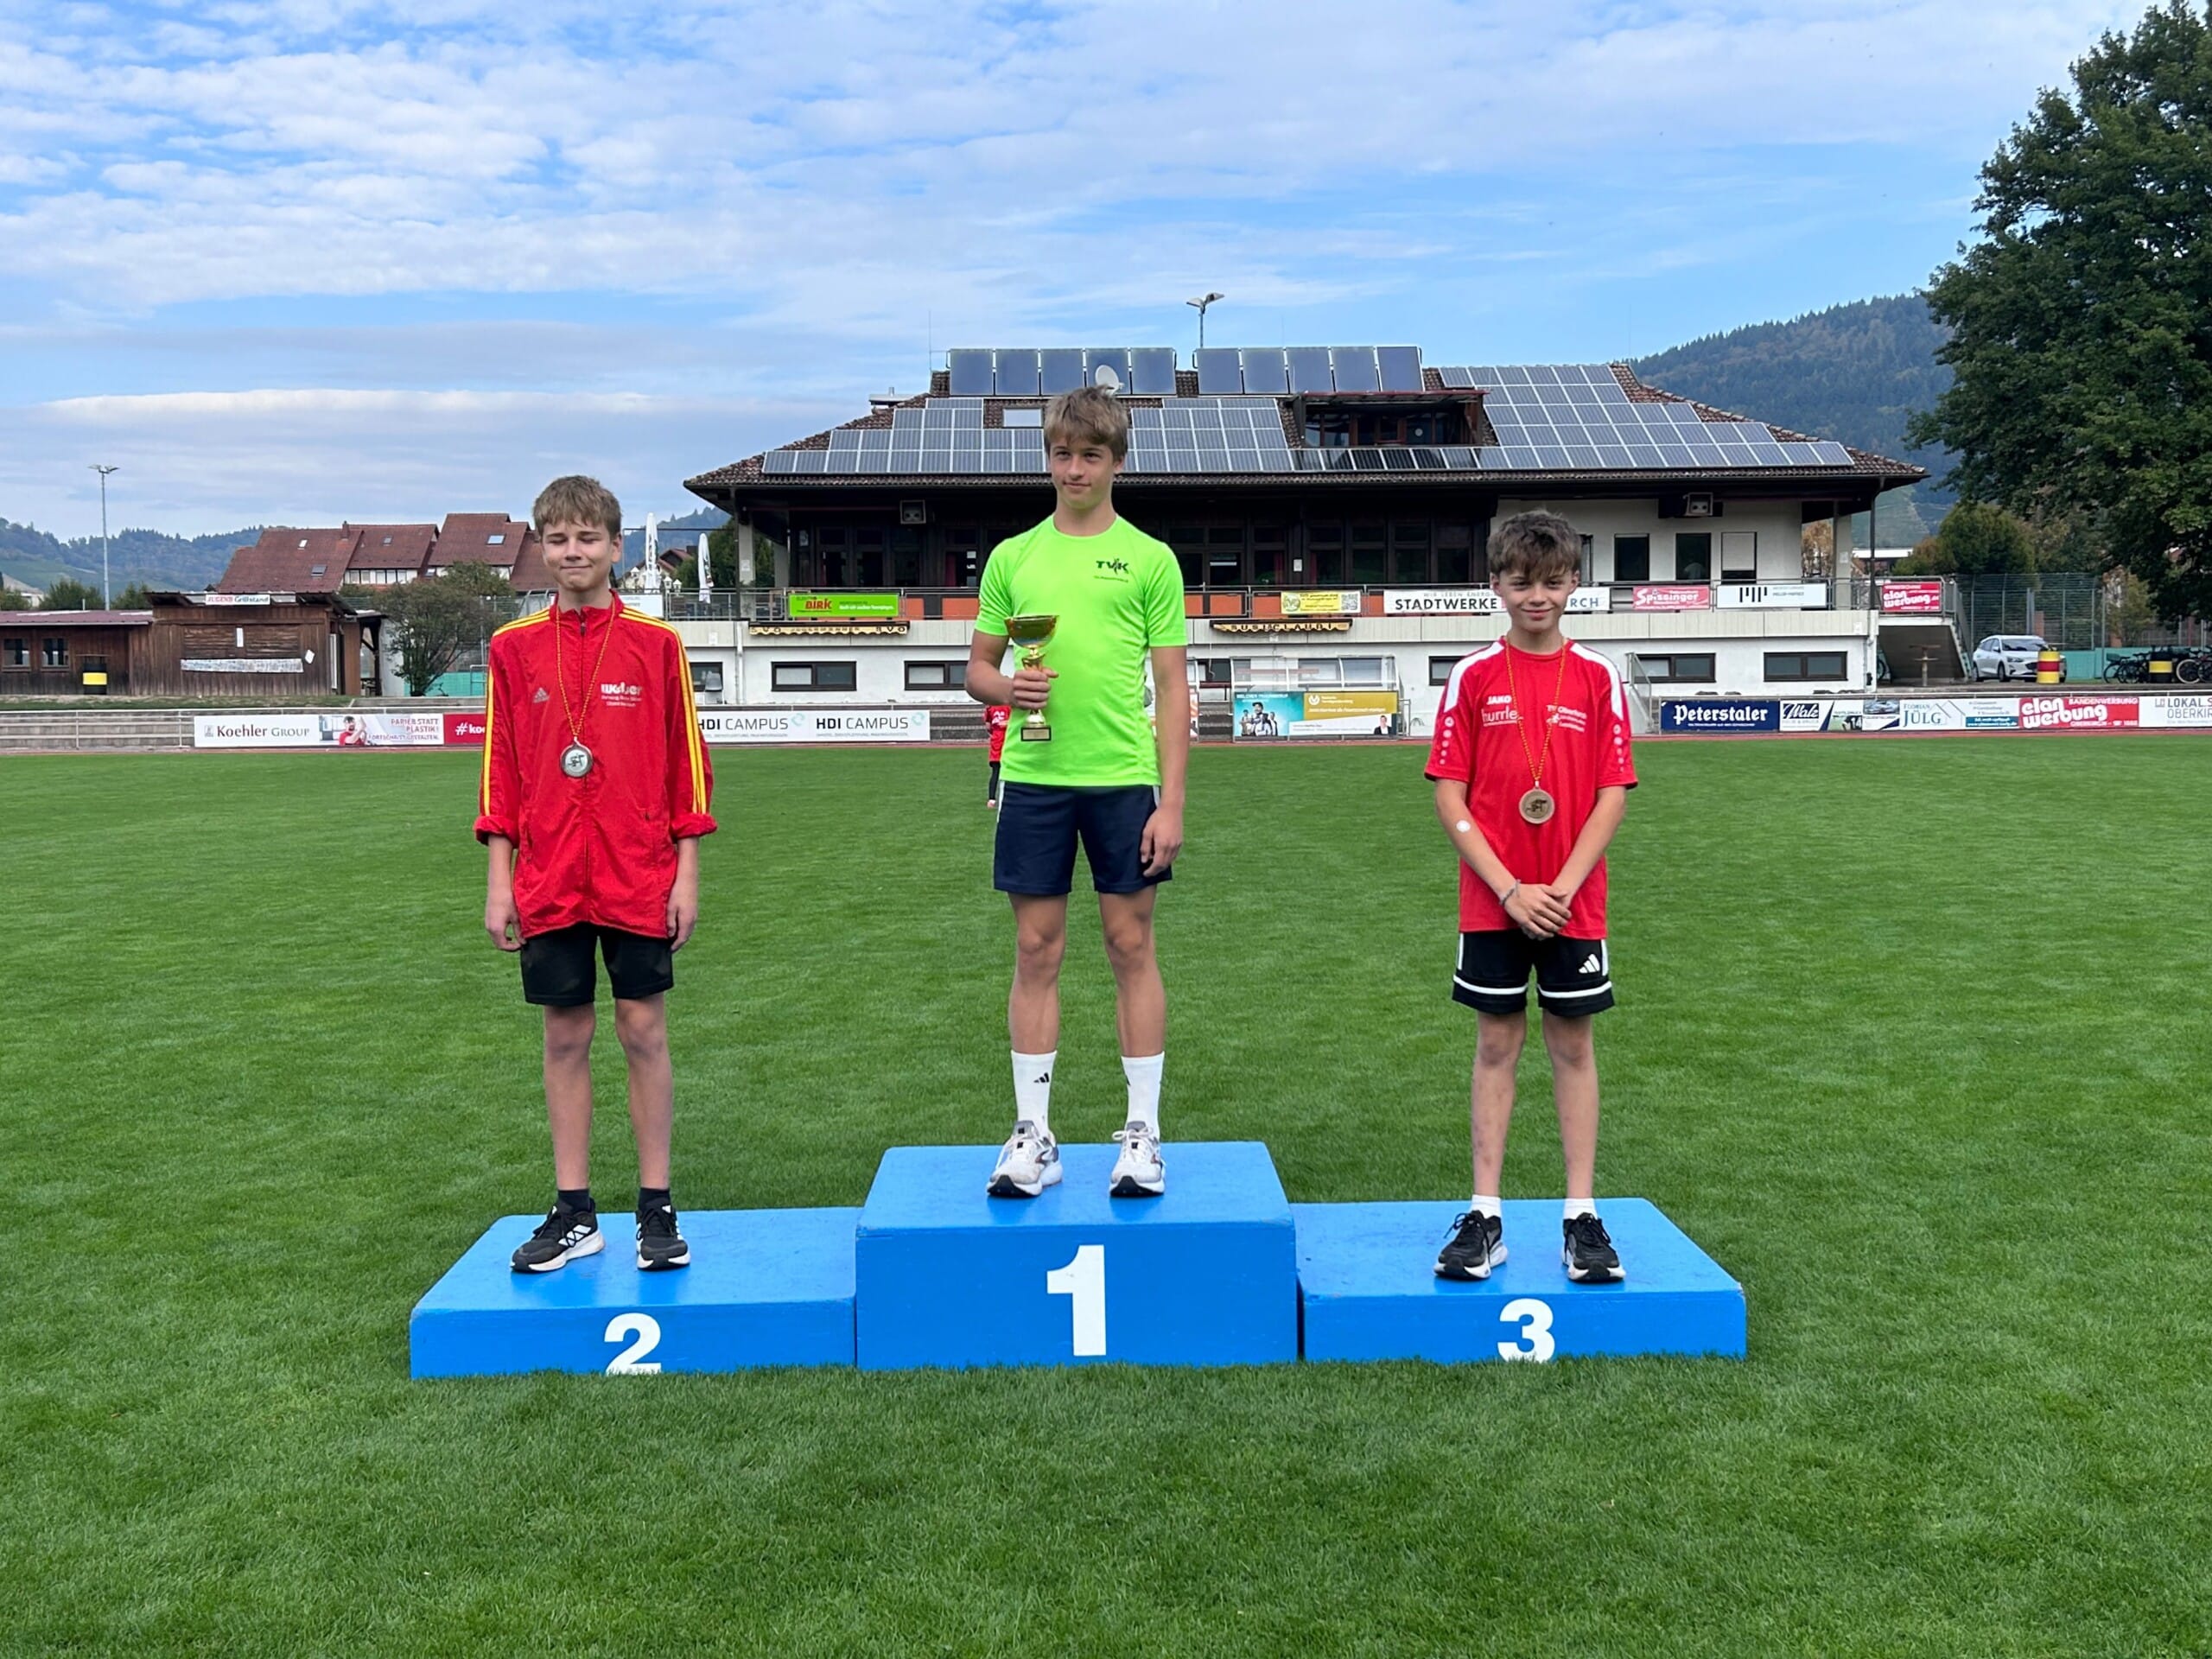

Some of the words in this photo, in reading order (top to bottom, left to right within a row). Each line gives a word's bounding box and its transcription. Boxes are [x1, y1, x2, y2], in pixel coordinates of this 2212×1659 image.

[1395, 598, 1497, 610] STADTWERKE
[1673, 704, 1768, 725] Peterstaler
[1783, 703, 1820, 719] Walz
[2021, 697, 2064, 715] elan
[726, 718, 788, 730] CAMPUS
[817, 718, 841, 729] HDI
[846, 717, 909, 729] CAMPUS
[1851, 717, 1862, 729] 14
[1903, 709, 1942, 728] JÜLG
[2023, 704, 2107, 728] werbung
[217, 724, 267, 737] Koehler
[271, 727, 309, 737] GROUP
[1046, 1244, 1107, 1357] 1
[1497, 1298, 1555, 1363] 3
[603, 1313, 662, 1375] 2
